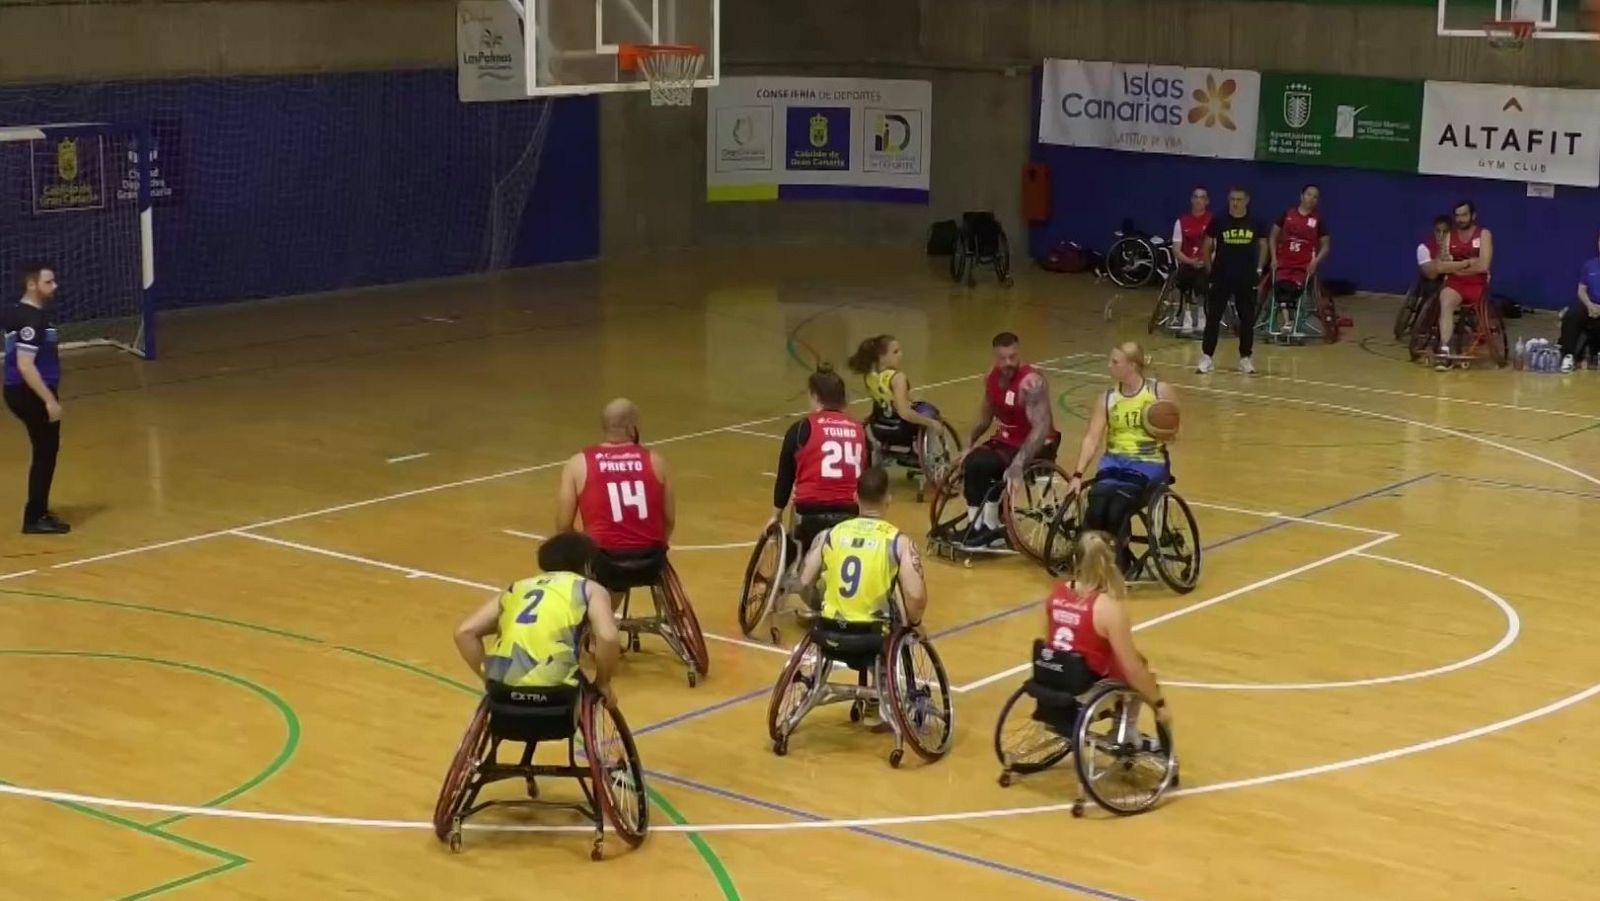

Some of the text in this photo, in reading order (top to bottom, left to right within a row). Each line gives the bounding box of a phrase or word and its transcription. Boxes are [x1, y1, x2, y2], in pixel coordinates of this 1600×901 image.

[756, 88, 816, 99] CONSEJERÍA
[833, 91, 882, 102] DEPORTES
[1123, 72, 1184, 99] Islas
[1062, 93, 1183, 126] Canarias
[1438, 124, 1582, 156] ALTAFIT
[1478, 159, 1547, 174] GYM CLUB
[1222, 228, 1254, 239] UCAM
[599, 460, 643, 473] PRIETO
[821, 441, 862, 479] 24
[606, 480, 649, 523] 14
[838, 554, 862, 599] 9
[515, 588, 546, 624] 2
[510, 691, 548, 703] EXTRA
